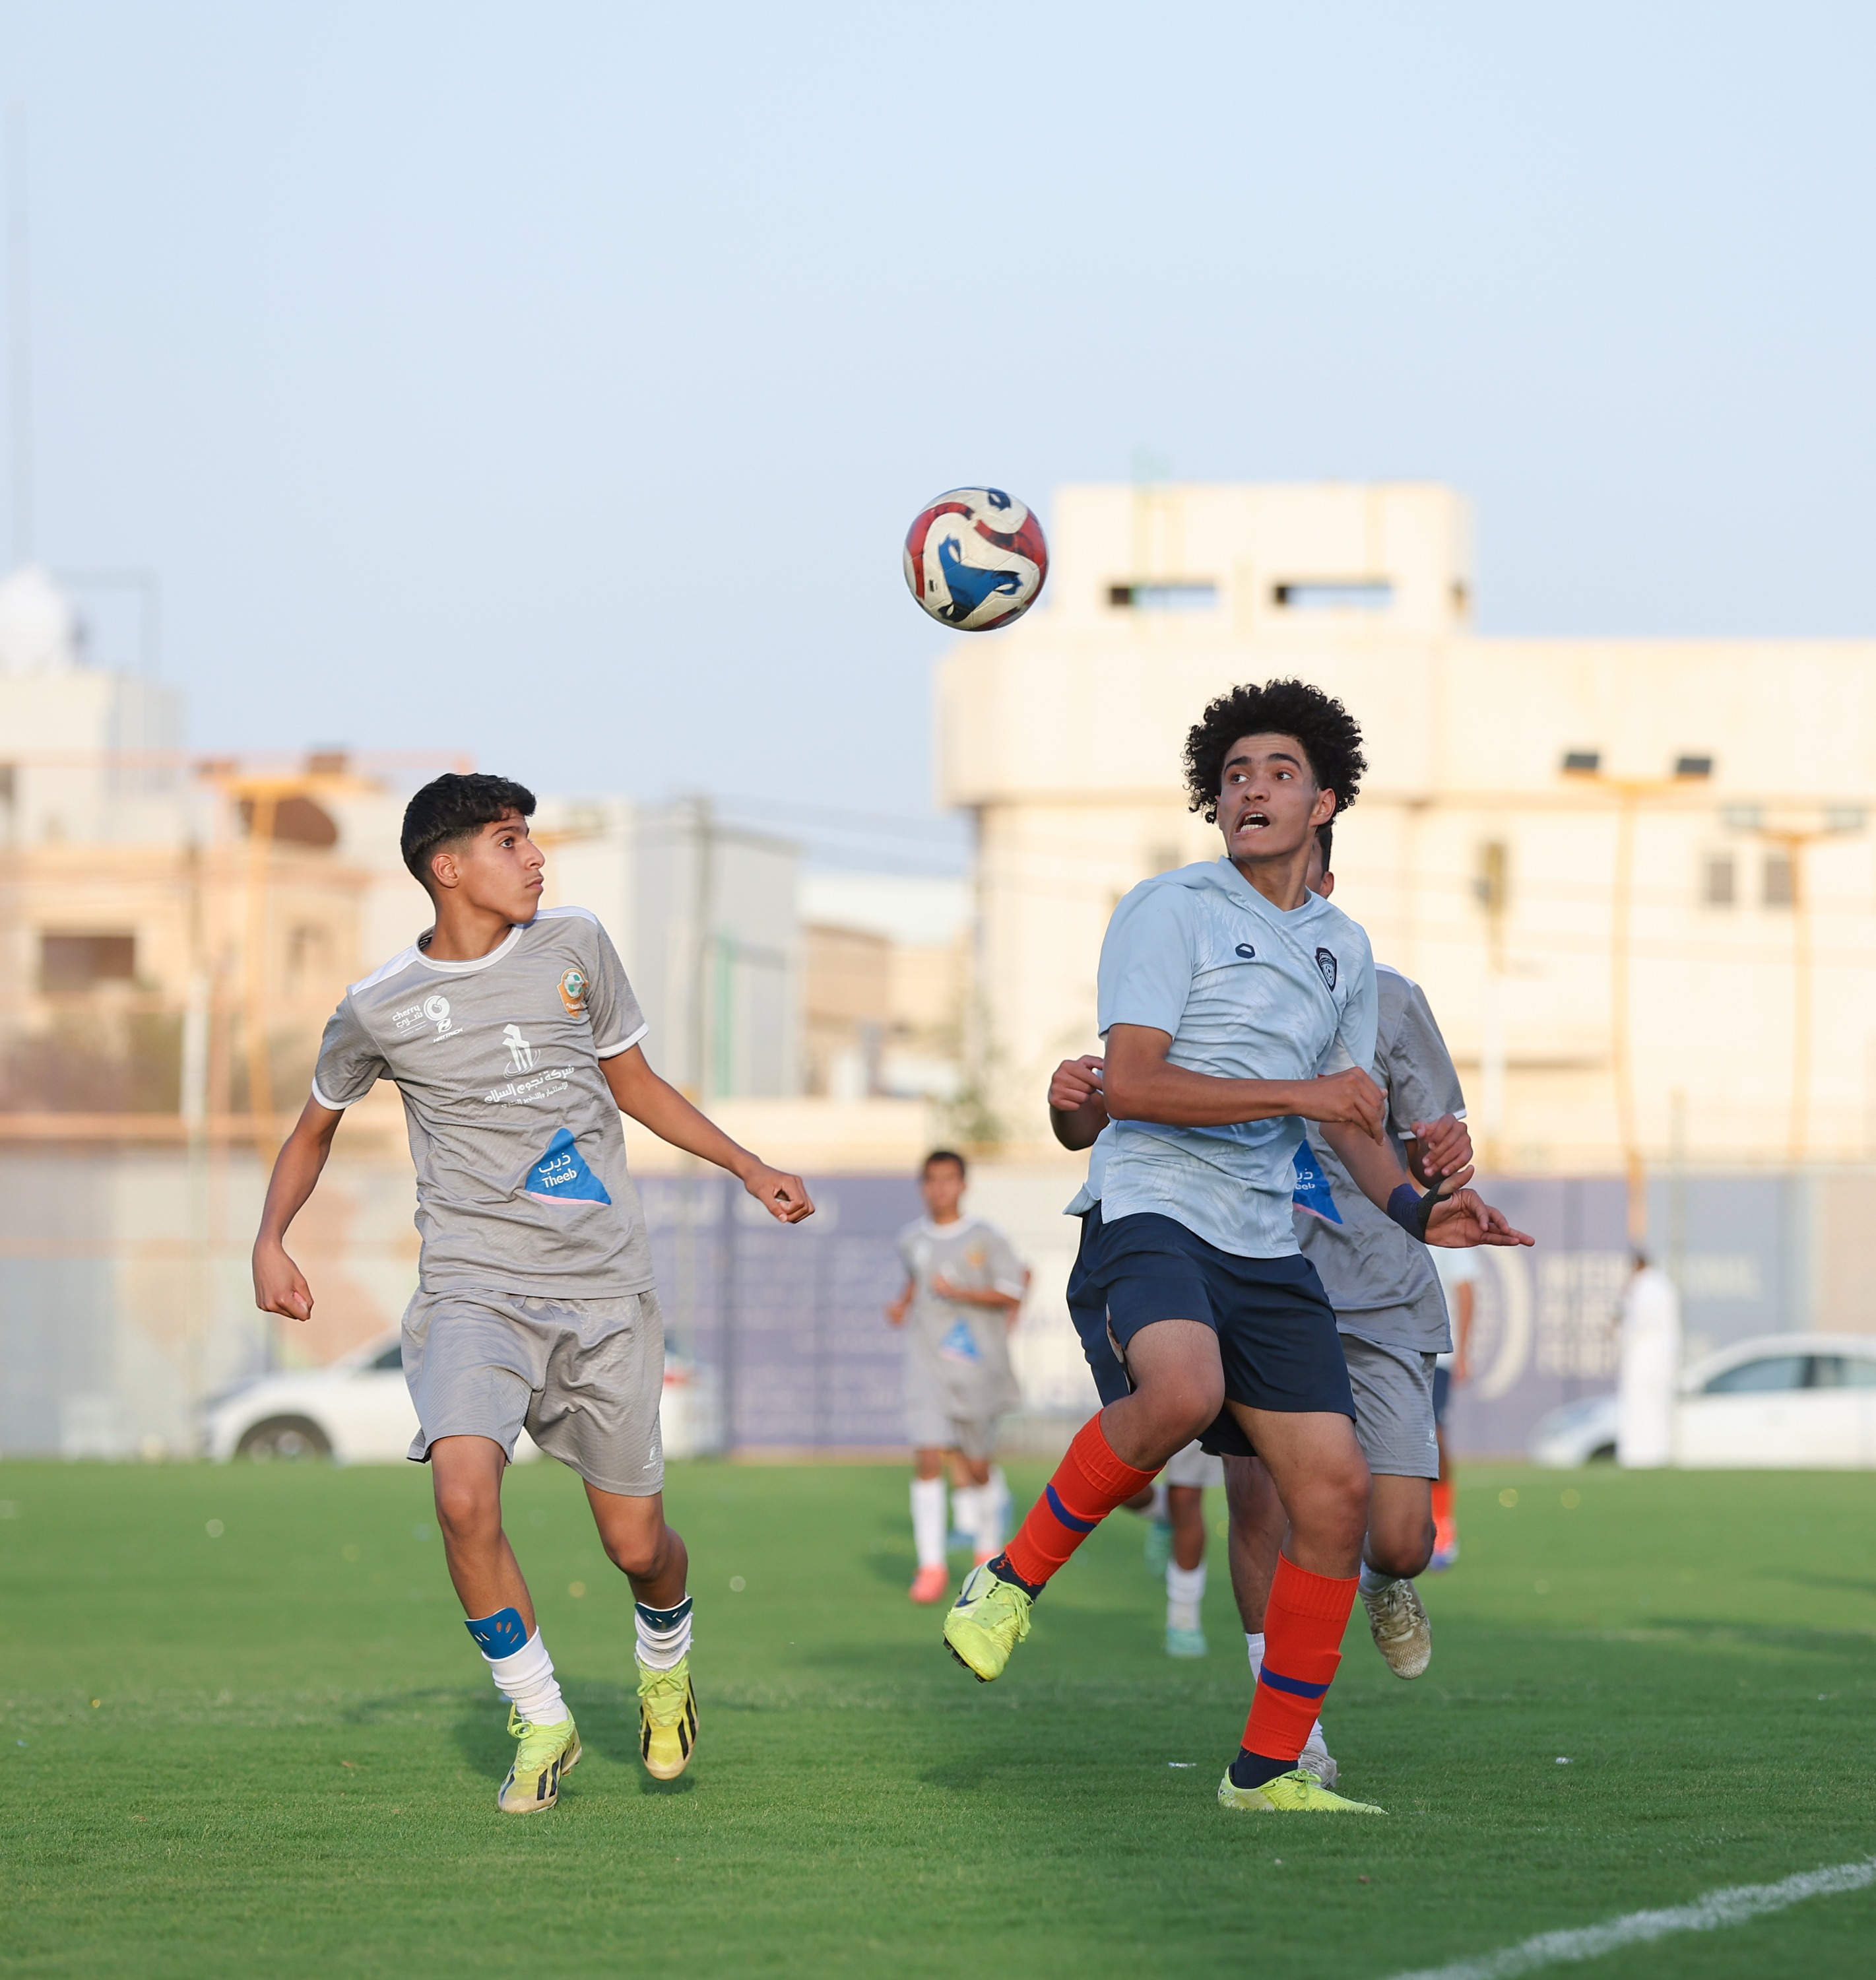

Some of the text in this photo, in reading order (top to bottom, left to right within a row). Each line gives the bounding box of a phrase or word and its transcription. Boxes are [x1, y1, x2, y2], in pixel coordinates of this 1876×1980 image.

[393, 1005, 421, 1021] cherry
[433, 1027, 463, 1043] HATTRICK
[484, 1064, 575, 1104] شركة نجوم السلام
[546, 1081, 568, 1097] للاستثمار
[523, 1091, 545, 1104] والتطوير
[538, 1152, 571, 1175] ذيب
[541, 1168, 577, 1188] Theeb
[1297, 1168, 1314, 1183] ذي
[1295, 1182, 1316, 1191] eeb
